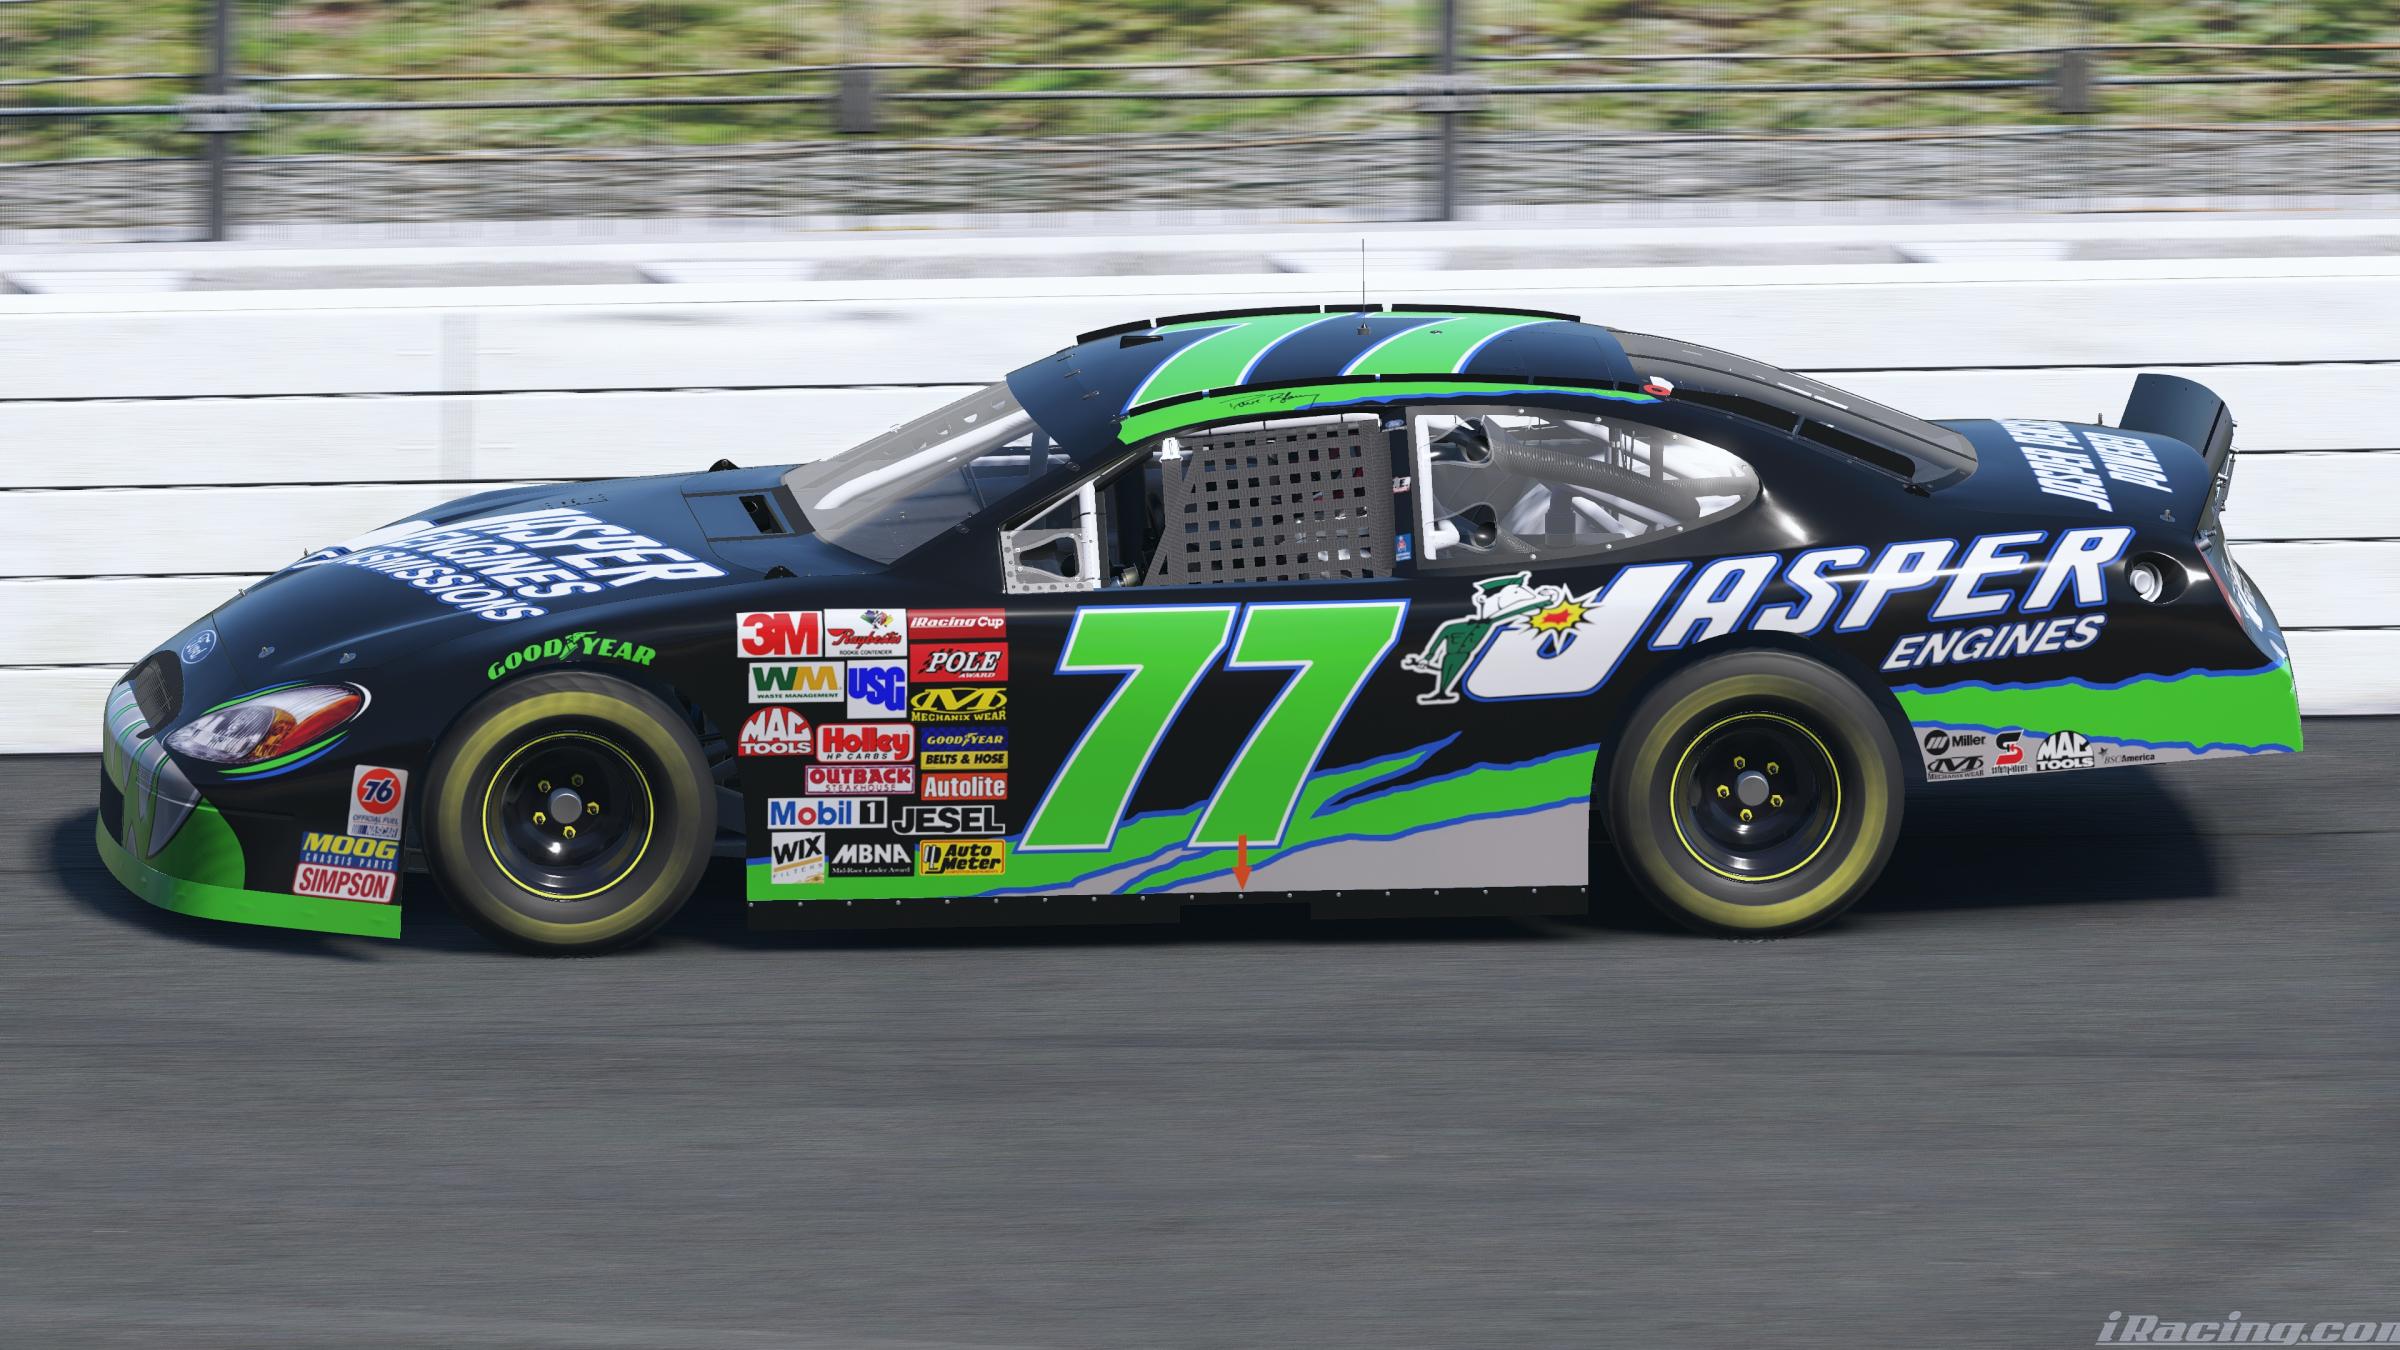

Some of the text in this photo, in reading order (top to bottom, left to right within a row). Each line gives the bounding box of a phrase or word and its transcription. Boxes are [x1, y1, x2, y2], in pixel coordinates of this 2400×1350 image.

[383, 531, 603, 599] ENGINES
[977, 615, 1004, 629] Cup
[1463, 526, 2134, 701] JASPER
[741, 612, 819, 657] 3M
[1882, 612, 2107, 671] ENGINES
[487, 633, 657, 681] GOODYEAR
[928, 651, 1002, 673] POLE
[752, 666, 839, 691] WM
[848, 666, 906, 711] USG
[742, 707, 813, 743] MAC
[911, 710, 1007, 722] MECHANIX WEAR
[1017, 600, 1409, 852] 77
[740, 743, 812, 753] TOOLS
[823, 726, 911, 760] Holley
[926, 732, 1004, 746] GOODYEAR
[1951, 734, 1986, 748] Miller
[2040, 731, 2092, 760] MAC
[846, 752, 889, 760] CARBS
[925, 753, 1005, 765] BELTS & HOSE
[2037, 758, 2095, 770] TOOLS
[2121, 753, 2155, 763] America
[809, 768, 911, 784] OUTBACK
[924, 776, 1006, 798] Autolite
[362, 778, 396, 804] 76
[825, 784, 897, 792] STEAKHOUSE
[770, 800, 853, 826] Mobil
[892, 805, 1006, 835] JESEL
[302, 832, 400, 860] MOOG
[773, 835, 823, 865] WIX
[831, 843, 912, 863] MBNA
[945, 844, 993, 858] Auto
[305, 852, 394, 871] CHASSIS PARTS
[865, 867, 887, 875] Leader
[888, 866, 911, 874] Award
[940, 857, 1002, 872] Meter
[298, 867, 390, 899] SIMPSON
